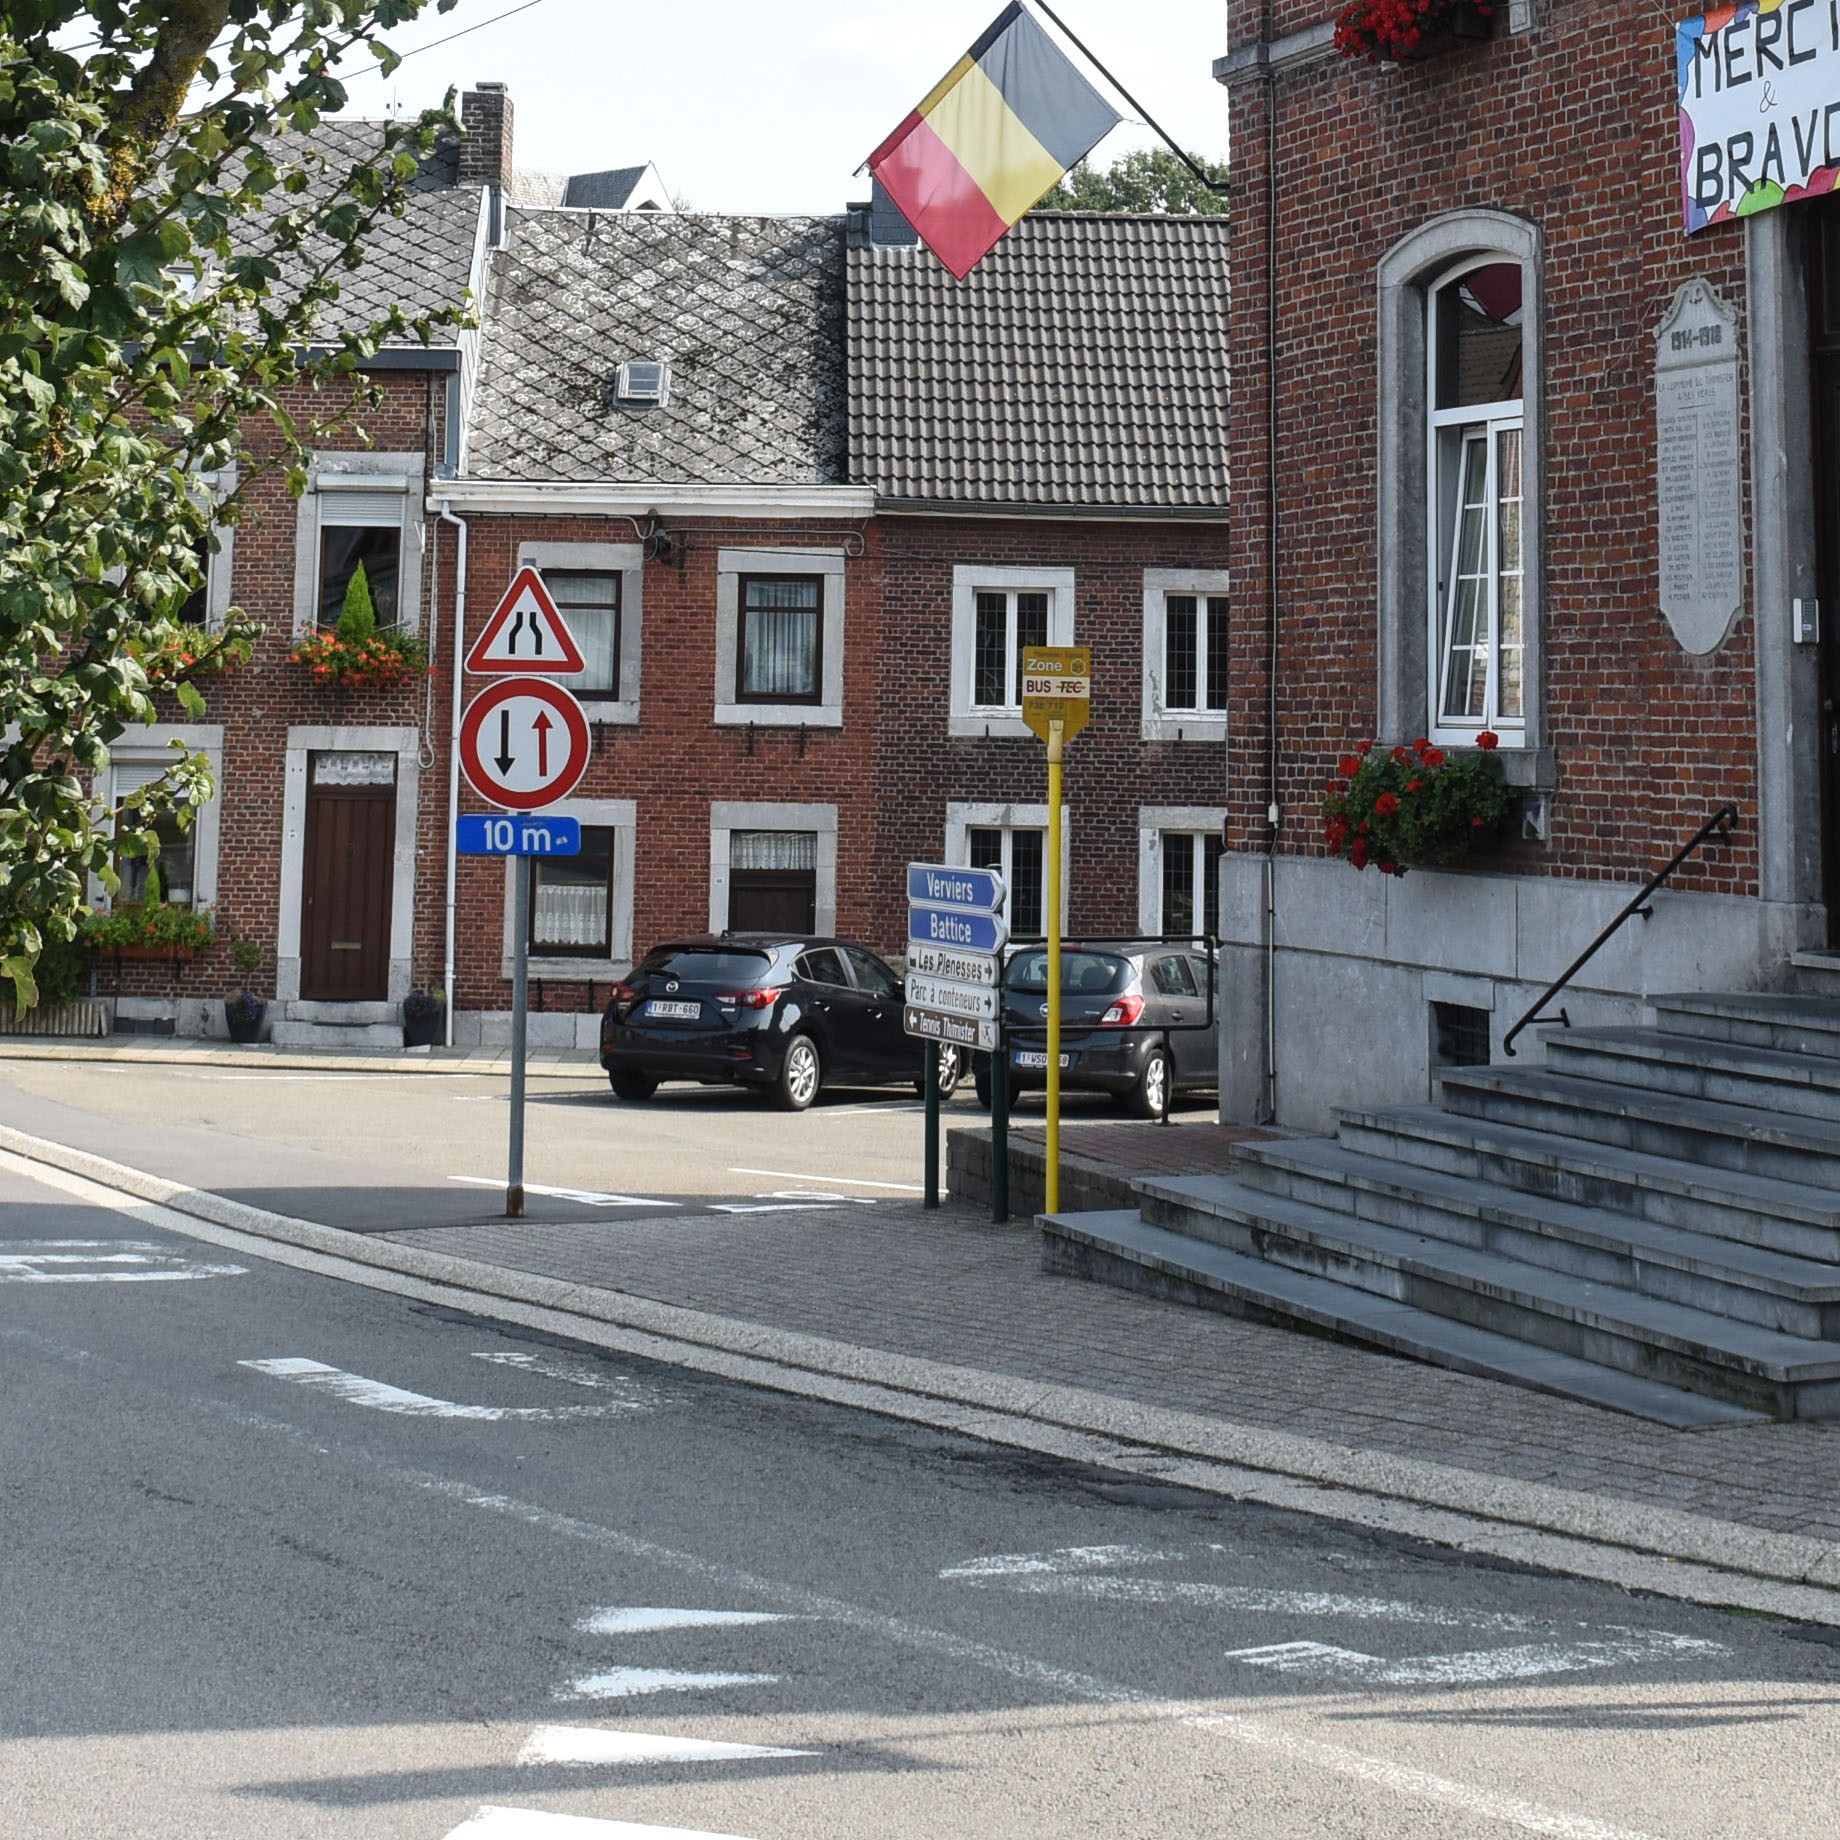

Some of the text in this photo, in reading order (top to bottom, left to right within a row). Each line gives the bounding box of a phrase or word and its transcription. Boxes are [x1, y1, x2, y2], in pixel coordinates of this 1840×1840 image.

[1027, 659, 1063, 671] Zone
[1026, 680, 1083, 693] BUS TEC
[483, 820, 551, 851] 10 m
[927, 872, 974, 902] Verviers
[930, 913, 972, 943] Battice
[918, 949, 934, 971] Les
[911, 978, 926, 1002] Parc
[938, 988, 981, 1012] conteneurs
[919, 1012, 976, 1042] Tennis Thimister
